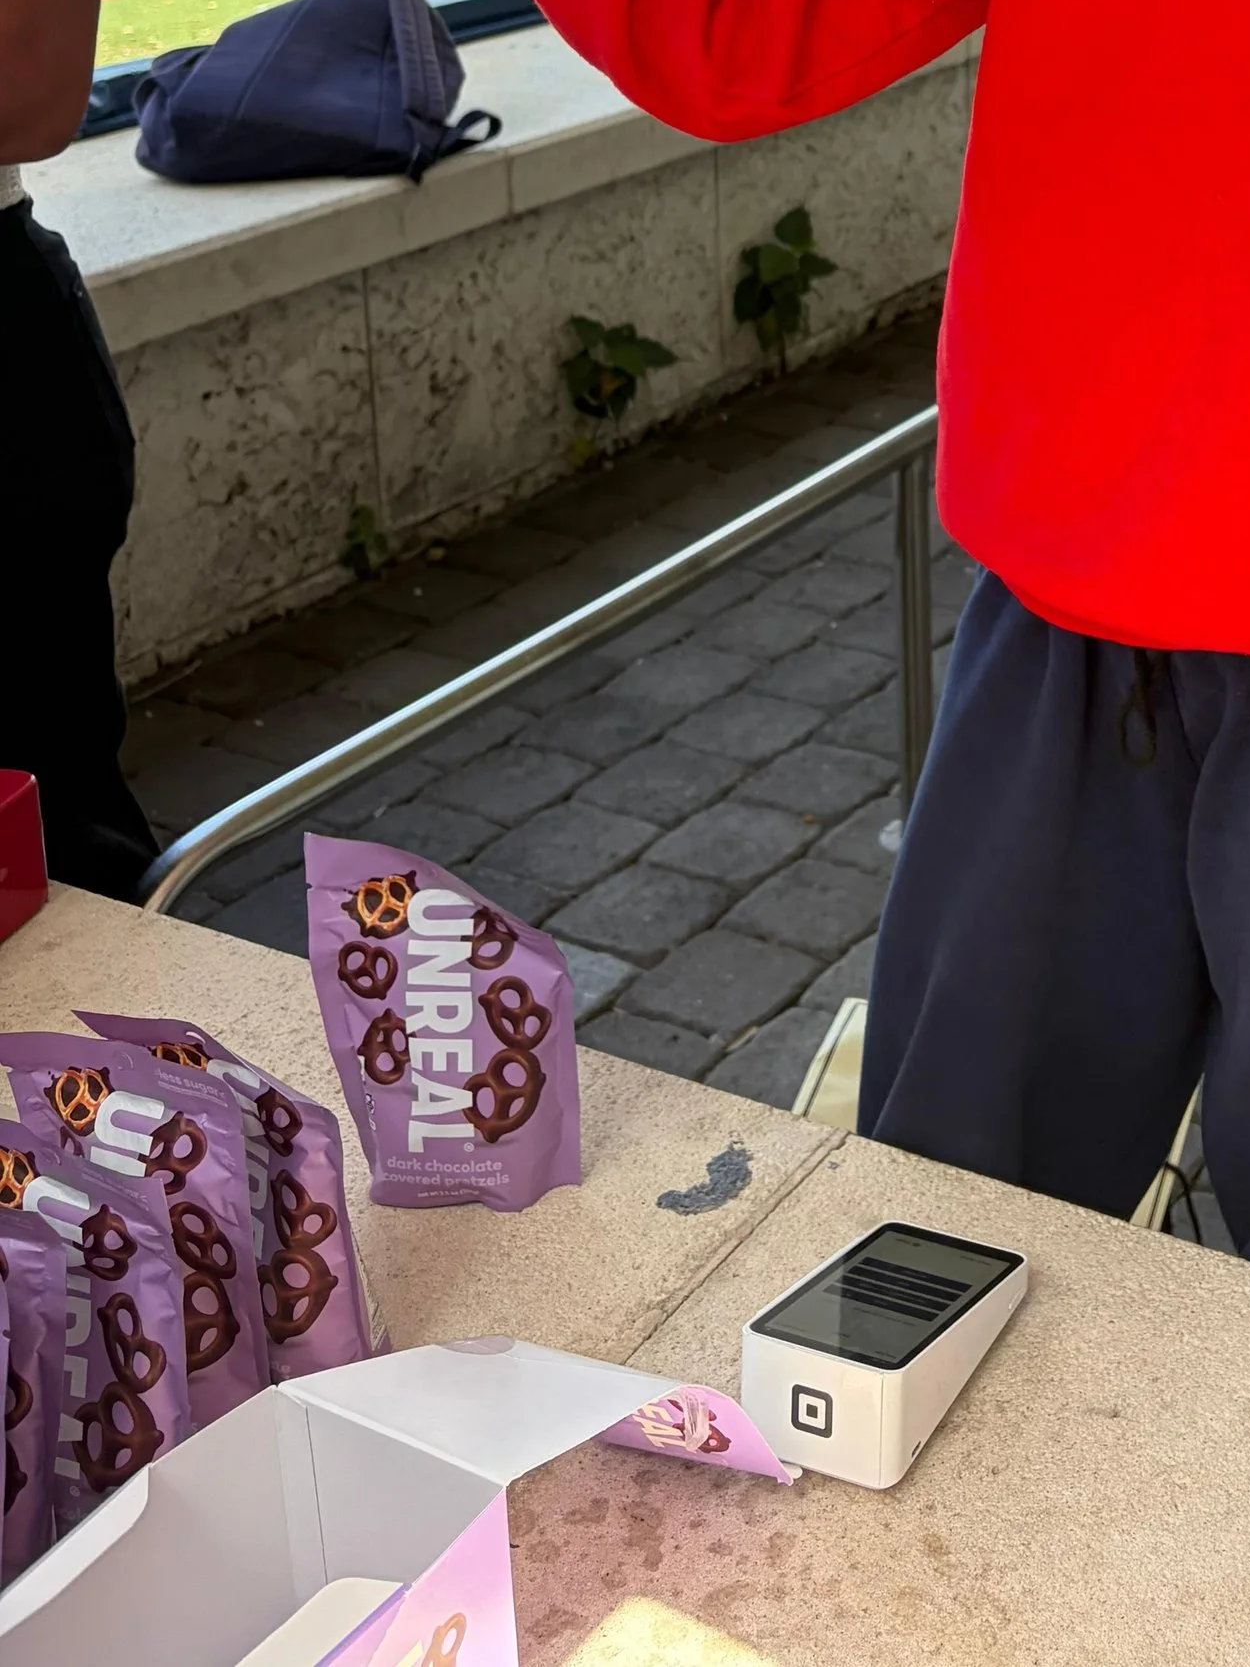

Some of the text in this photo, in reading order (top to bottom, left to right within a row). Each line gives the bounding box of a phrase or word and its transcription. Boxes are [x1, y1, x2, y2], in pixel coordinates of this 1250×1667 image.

[405, 888, 476, 1154] UNREAL
[382, 1172, 510, 1187] covered pretzels
[386, 1155, 503, 1173] dark chocolate
[632, 1403, 698, 1454] EAL
